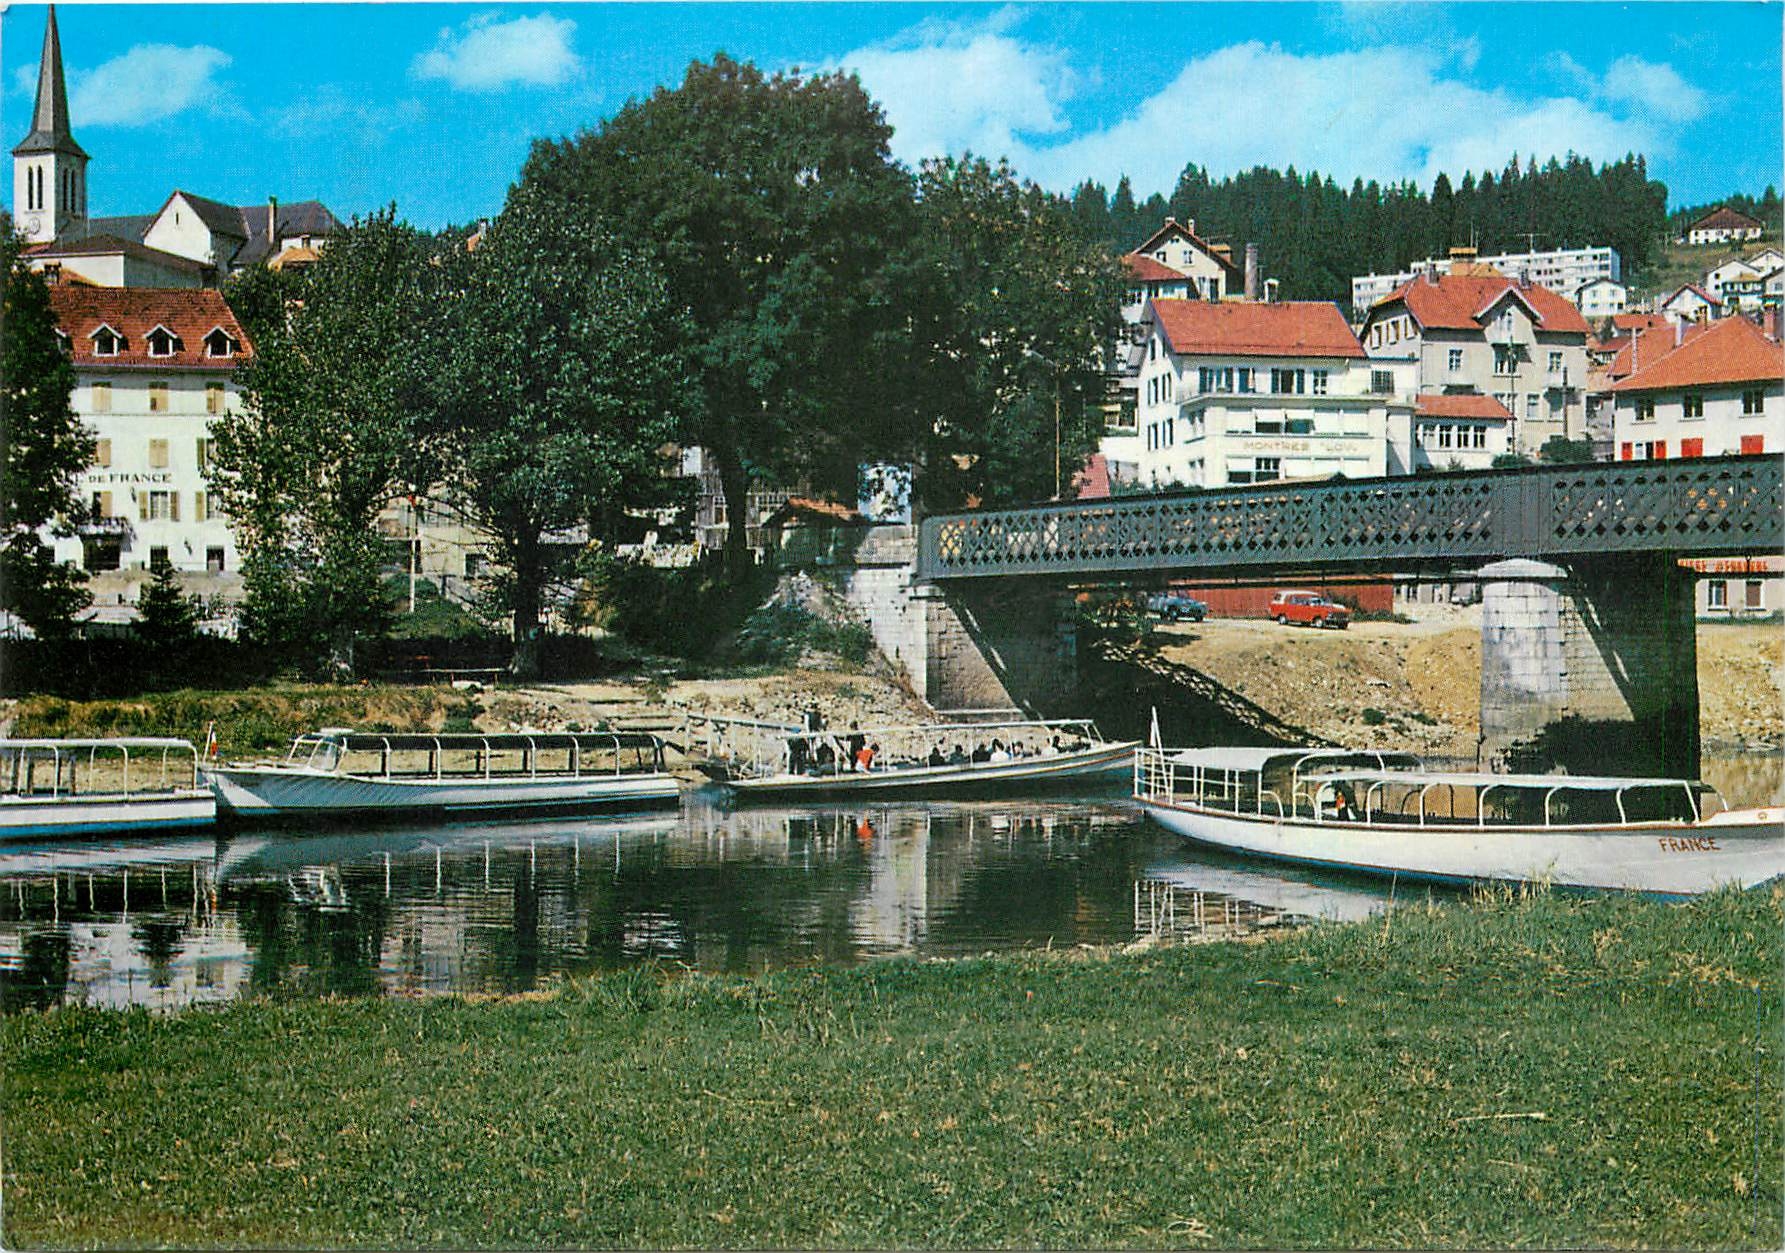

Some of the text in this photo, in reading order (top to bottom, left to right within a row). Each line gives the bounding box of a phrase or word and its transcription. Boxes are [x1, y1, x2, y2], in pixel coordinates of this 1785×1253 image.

[89, 475, 106, 484] DE
[109, 473, 173, 484] FRANCE
[1658, 837, 1721, 852] FRANCE
